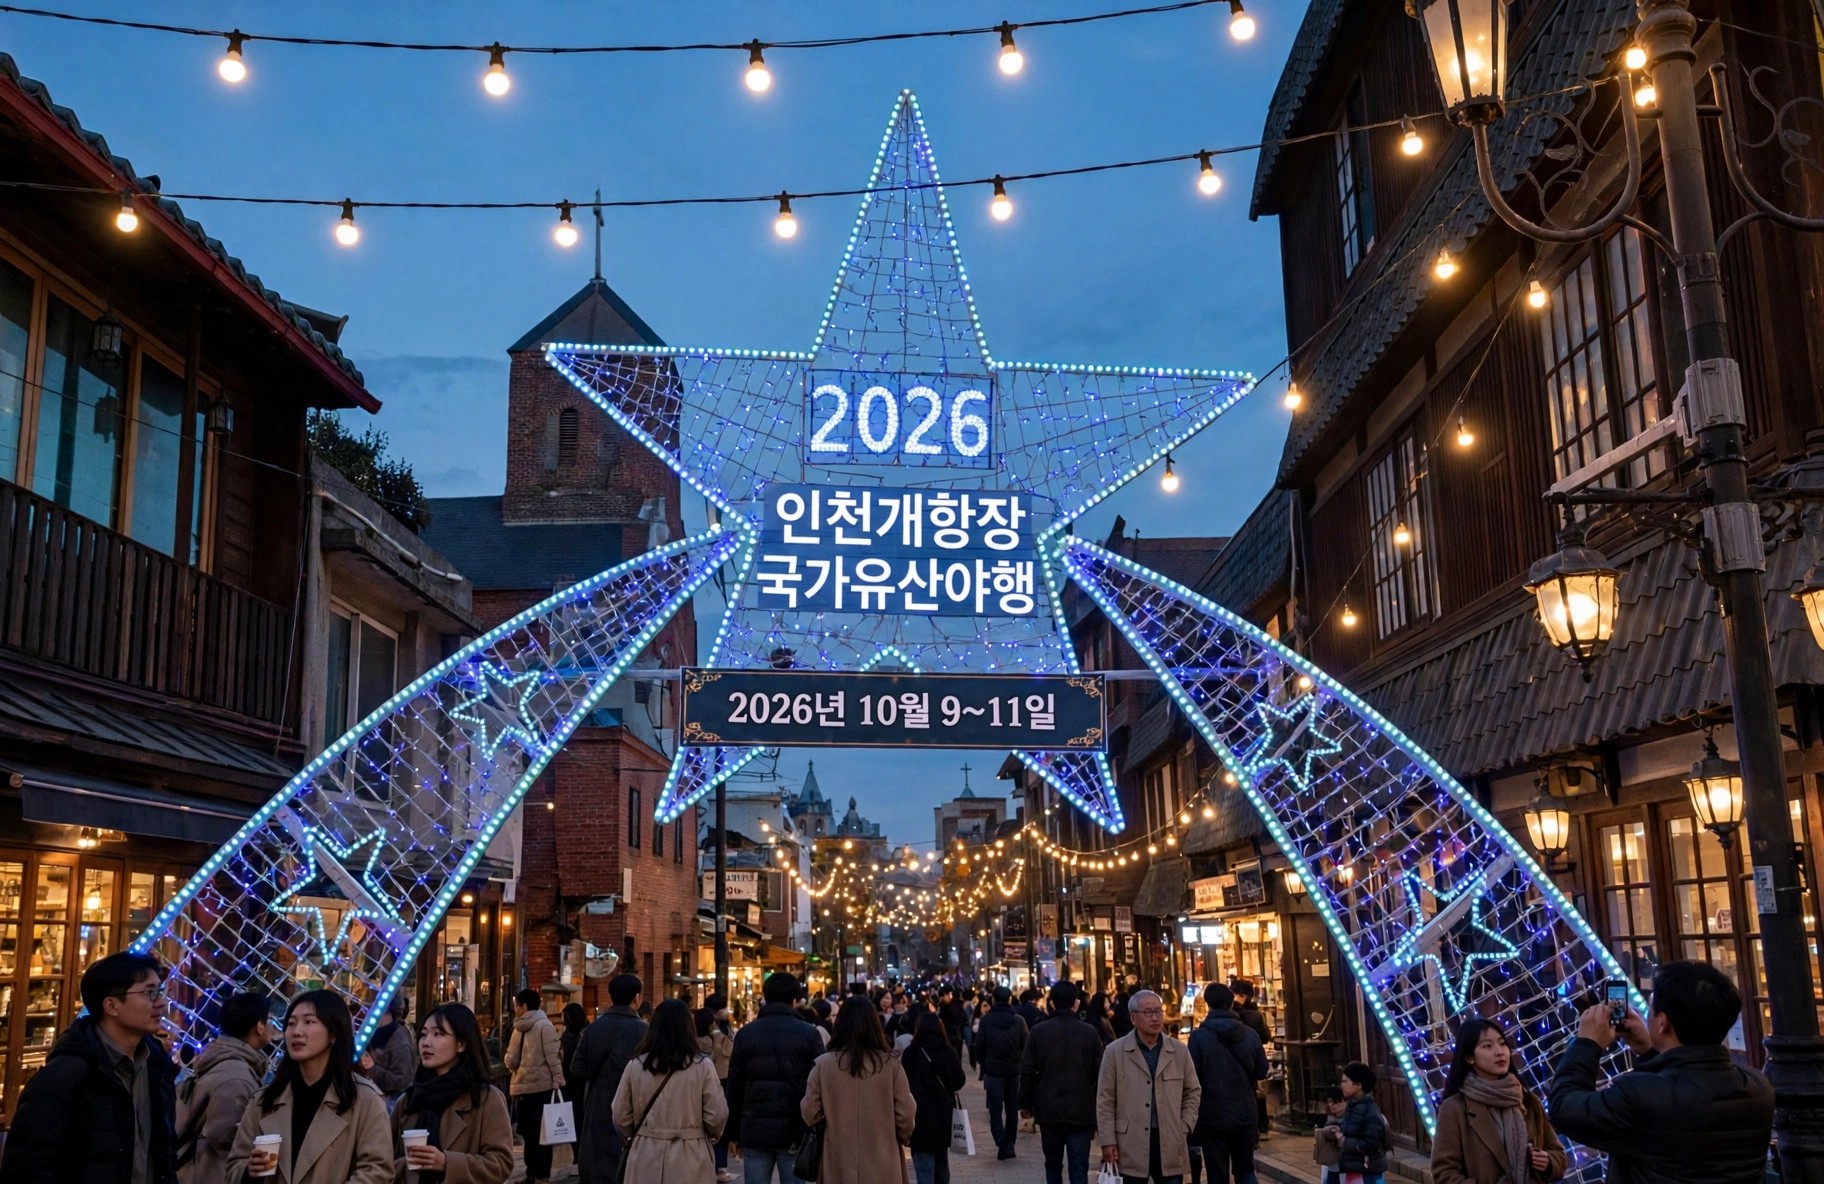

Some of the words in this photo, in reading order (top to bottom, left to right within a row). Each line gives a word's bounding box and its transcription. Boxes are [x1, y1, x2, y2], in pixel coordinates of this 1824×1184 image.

[811, 384, 988, 457] 2026
[776, 490, 1026, 550] 인천개항장
[757, 555, 1034, 615] 국가유산야행
[728, 691, 846, 728] 2026년
[860, 692, 930, 729] 10월
[941, 693, 1056, 730] 9~11일
